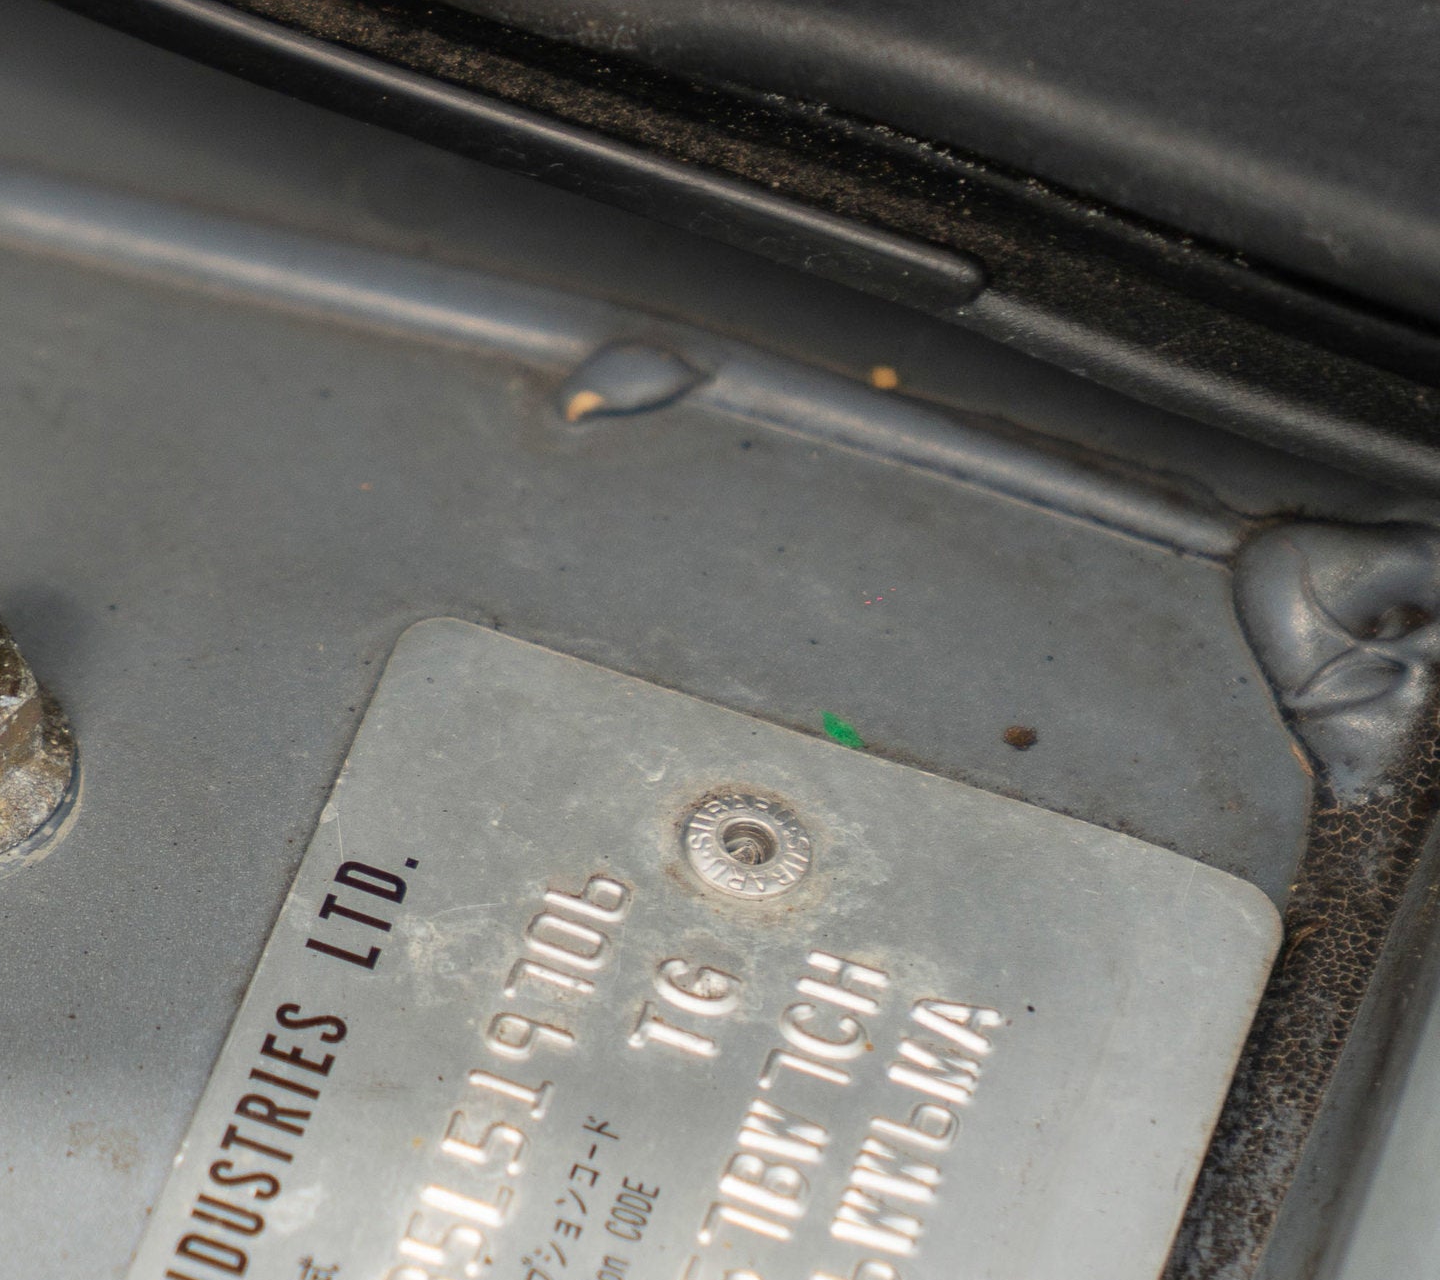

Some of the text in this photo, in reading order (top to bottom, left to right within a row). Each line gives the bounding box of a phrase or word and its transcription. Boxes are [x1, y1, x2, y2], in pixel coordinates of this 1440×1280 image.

[306, 852, 420, 971] LTD.
[628, 946, 745, 1076] TG
[605, 1173, 660, 1242] CODE
